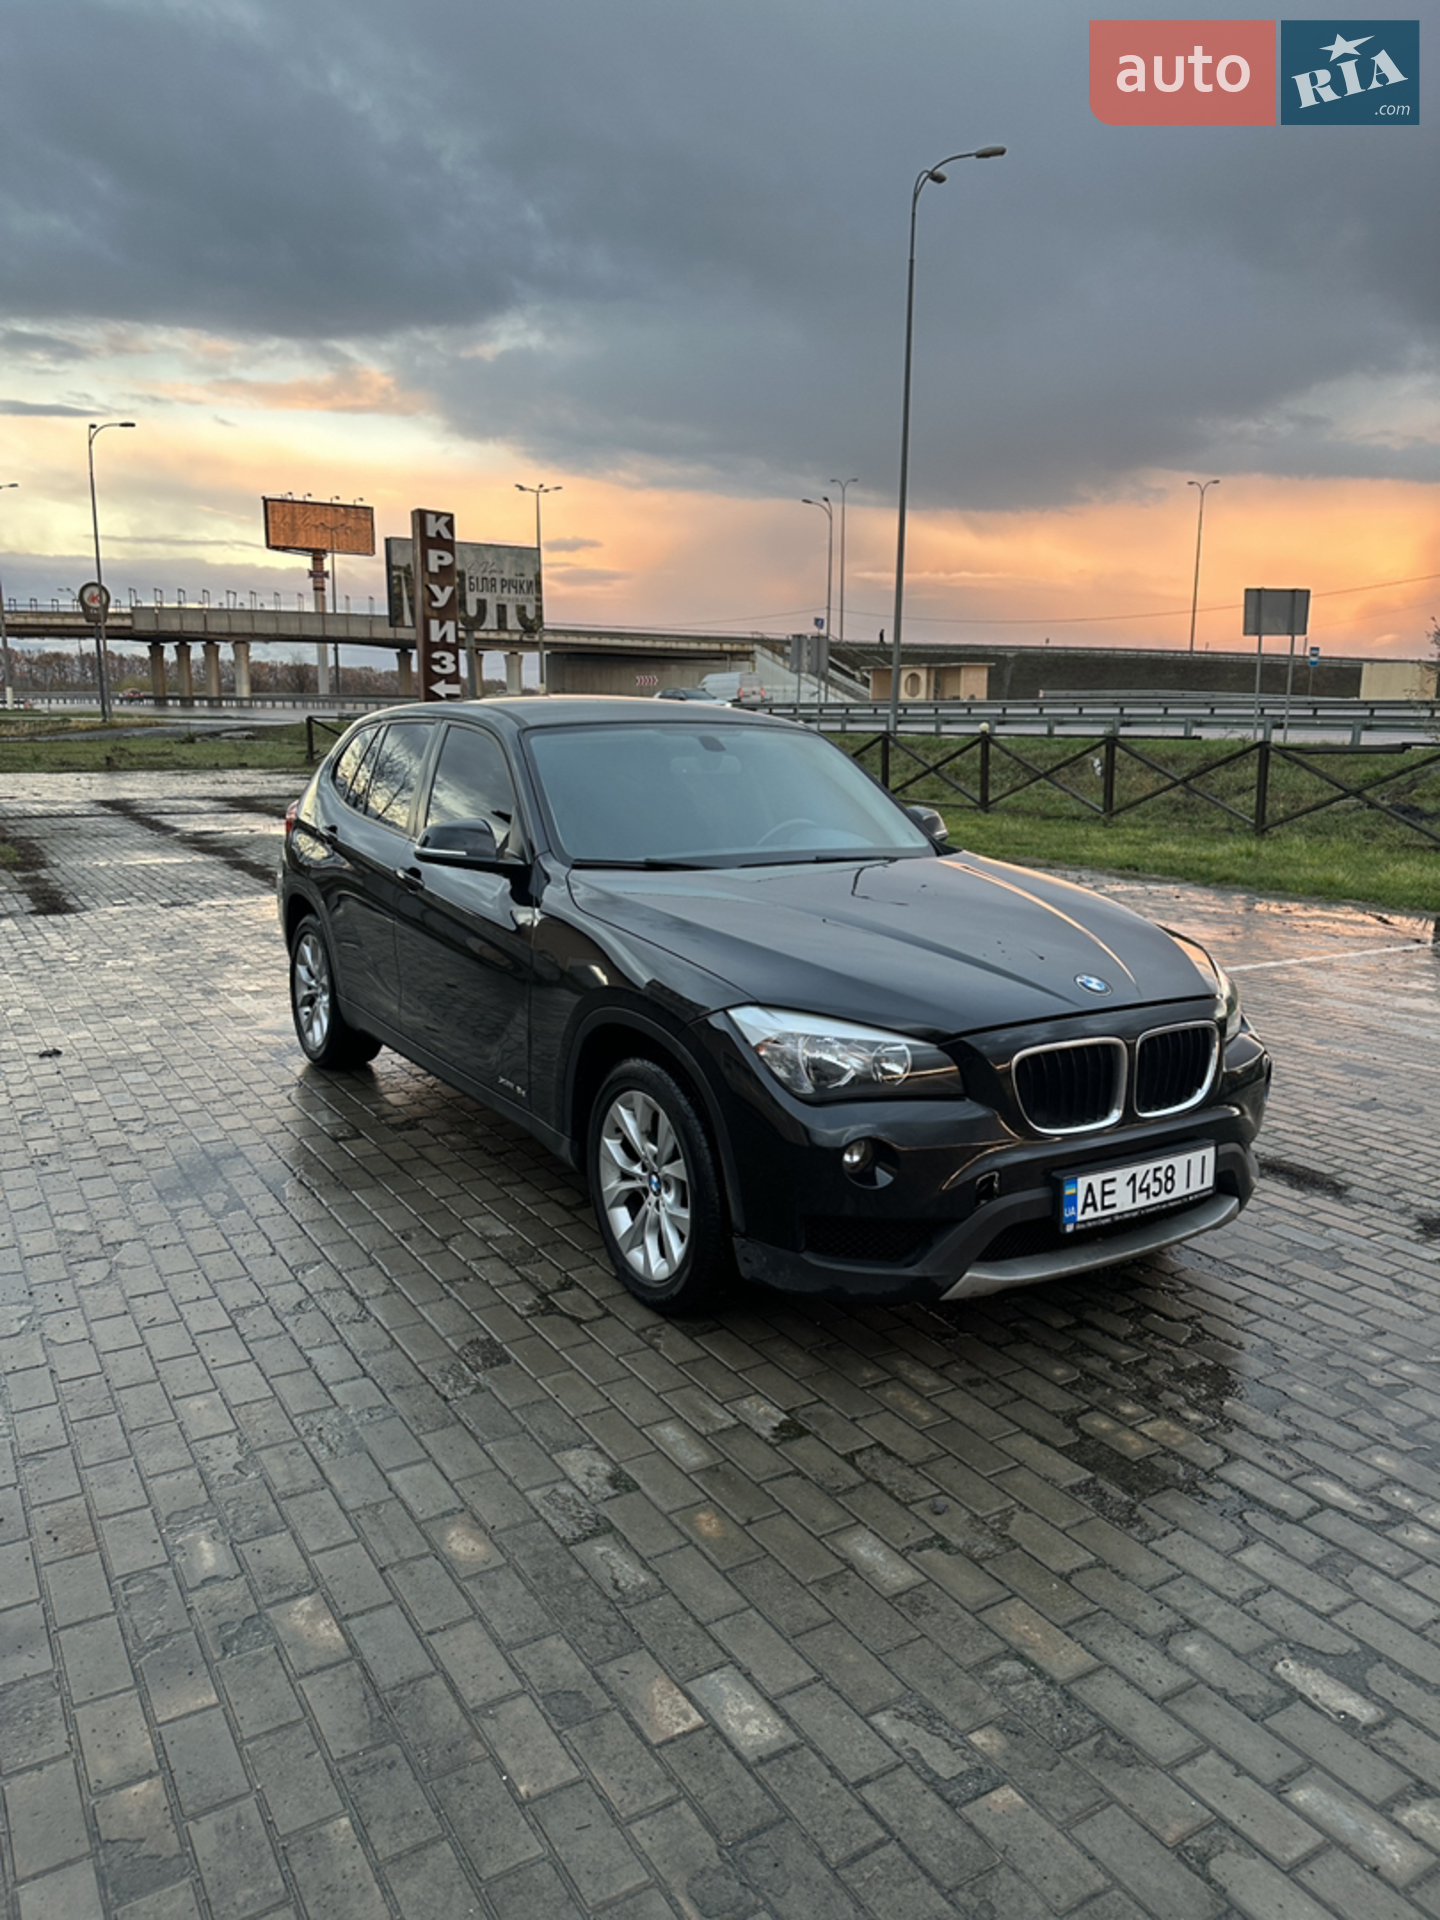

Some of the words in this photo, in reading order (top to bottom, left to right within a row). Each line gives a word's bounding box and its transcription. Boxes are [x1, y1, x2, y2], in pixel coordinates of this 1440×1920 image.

[424, 512, 457, 675] КРУИЗ
[468, 575, 497, 594] БІЛЯ
[500, 577, 534, 596] РІЧКИ
[1080, 1177, 1117, 1216] AE
[1126, 1163, 1176, 1204] 1458
[1064, 1205, 1077, 1218] UA
